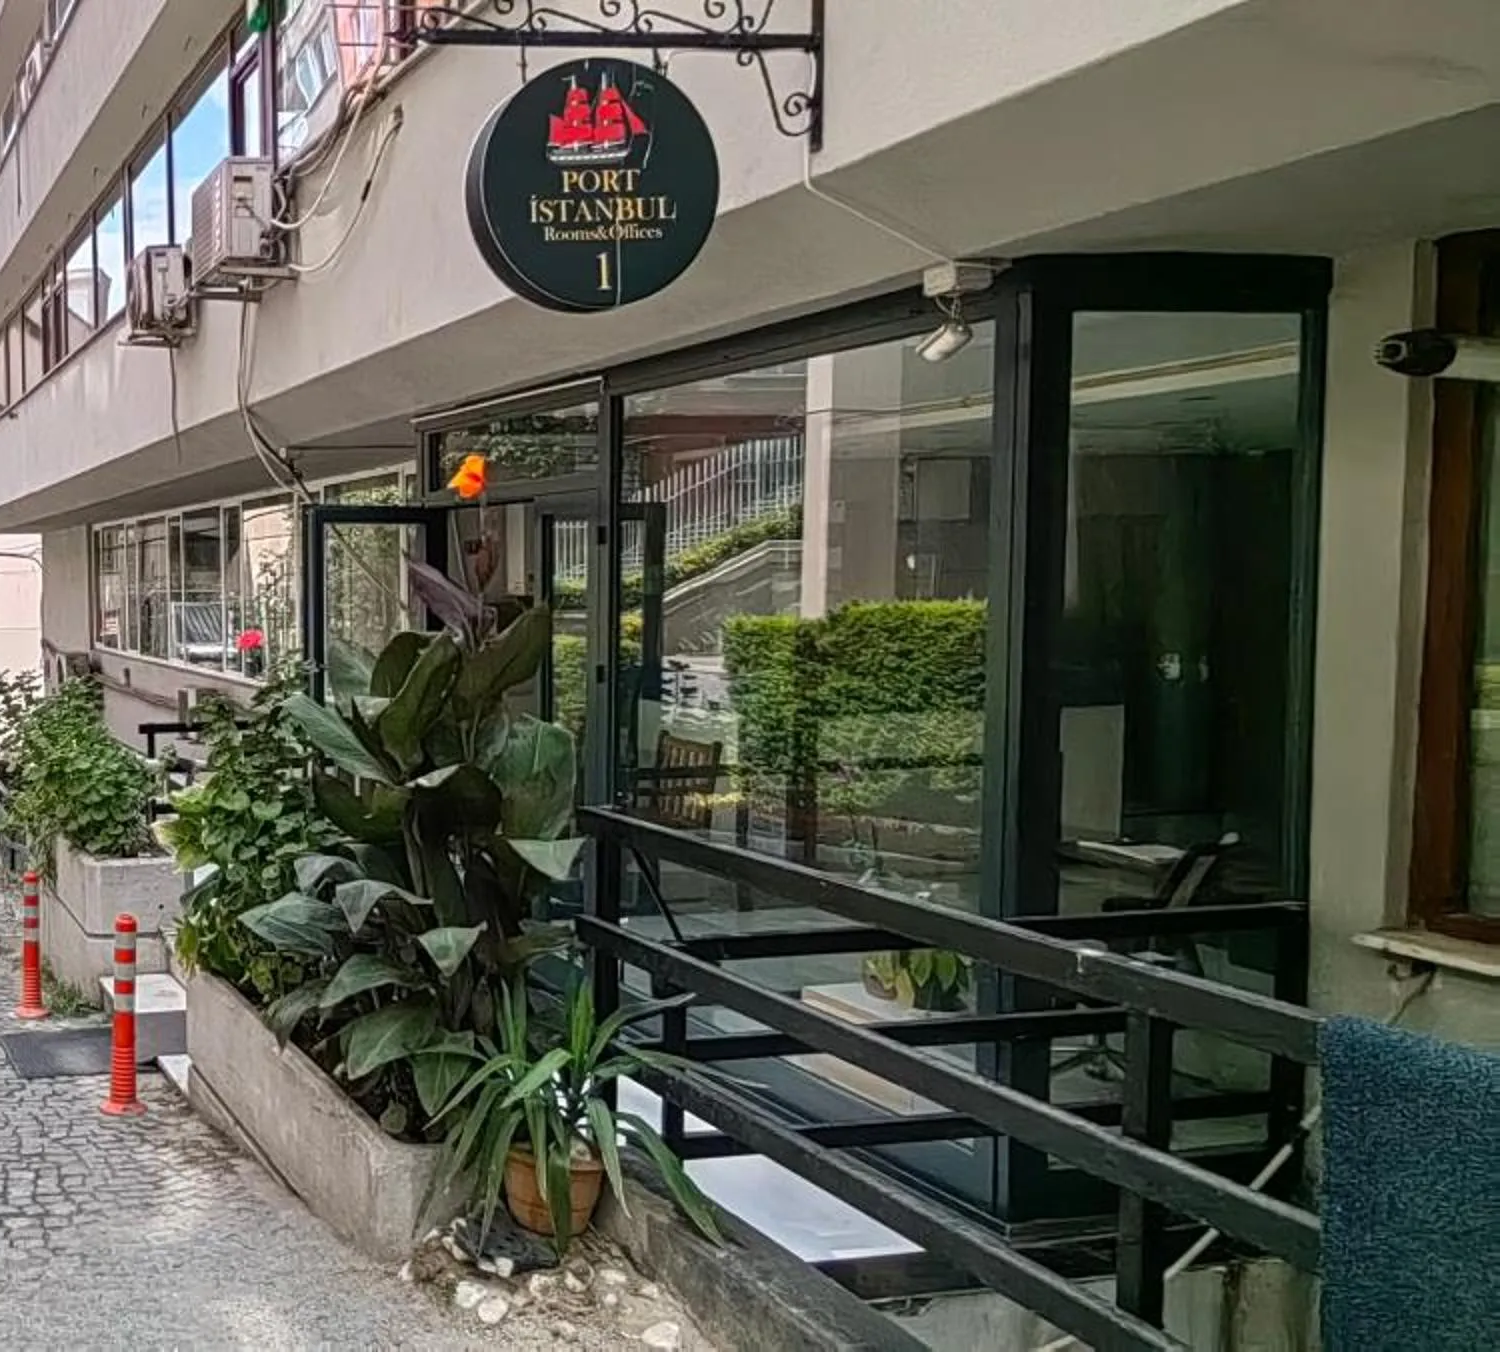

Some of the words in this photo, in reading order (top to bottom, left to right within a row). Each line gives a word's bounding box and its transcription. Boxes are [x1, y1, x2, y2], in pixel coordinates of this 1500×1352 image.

[561, 169, 641, 193] PORT
[530, 194, 677, 223] İSTANBUL
[543, 223, 663, 241] Rooms&Offices
[596, 252, 612, 291] 1
